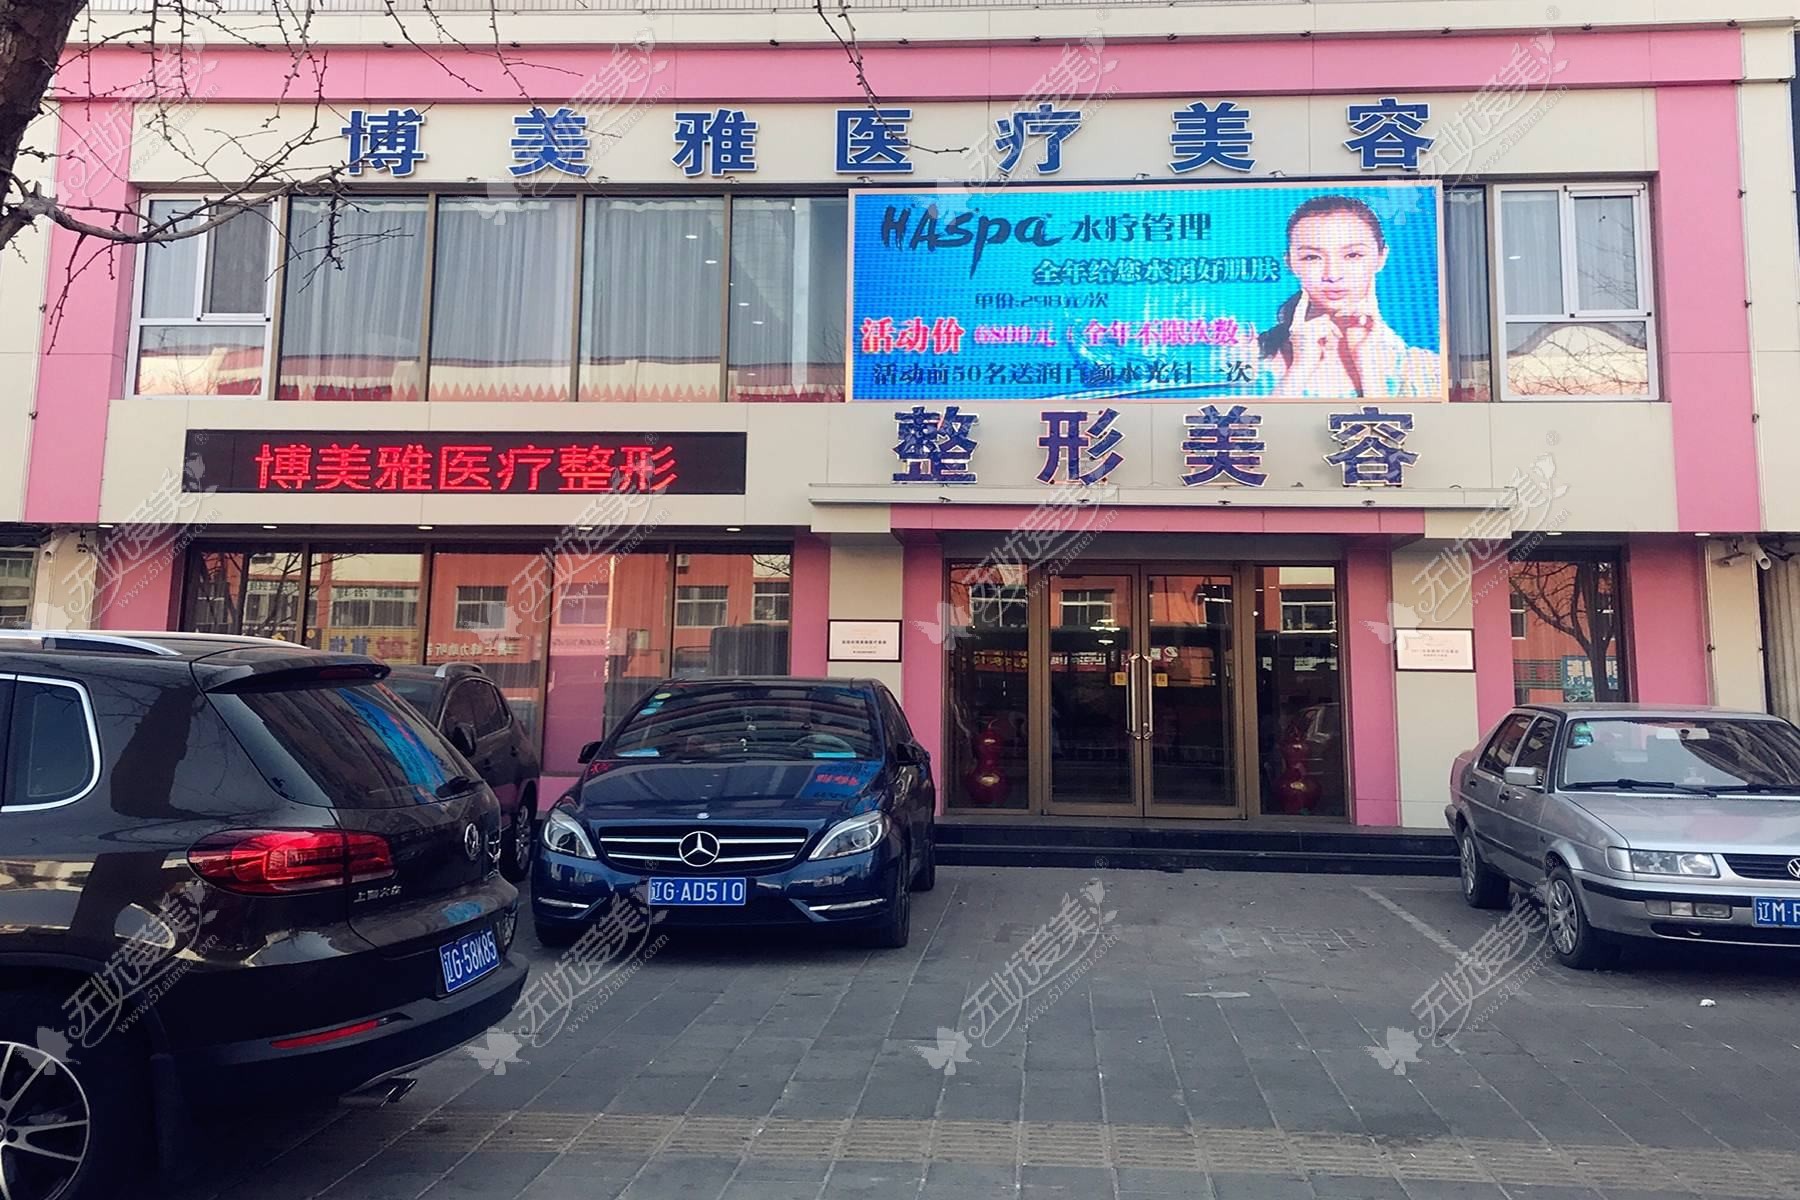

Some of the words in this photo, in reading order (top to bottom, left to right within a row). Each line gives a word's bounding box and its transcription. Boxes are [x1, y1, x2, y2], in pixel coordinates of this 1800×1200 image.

[341, 97, 1435, 178] 博美雅医疗美容
[1071, 213, 1211, 243] 水疗管理
[1033, 257, 1279, 286] 全年给您水润好肌肤
[861, 315, 966, 355] 活动价
[255, 443, 679, 492] 博美雅医疗整形
[891, 405, 1422, 487] 整形美容
